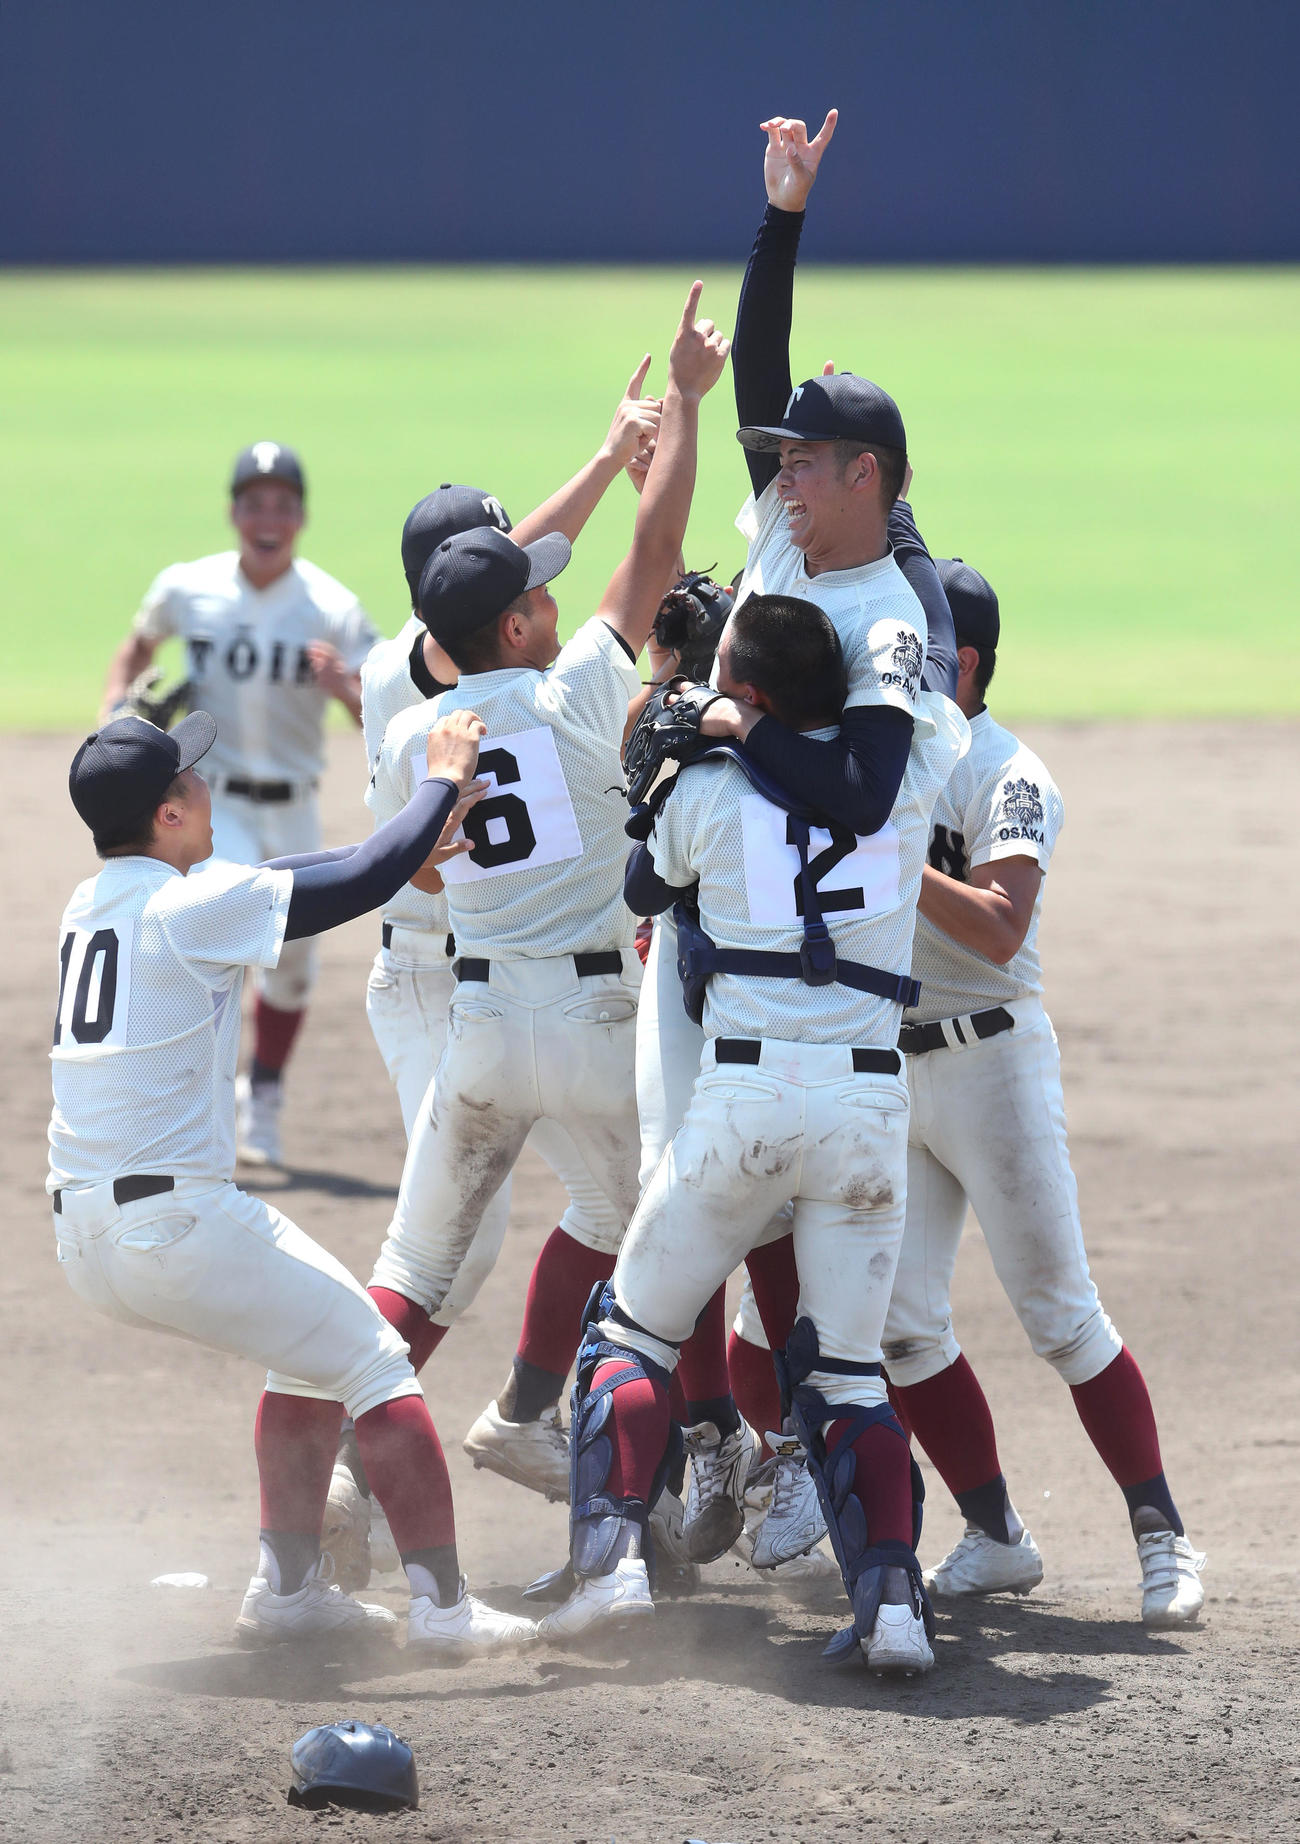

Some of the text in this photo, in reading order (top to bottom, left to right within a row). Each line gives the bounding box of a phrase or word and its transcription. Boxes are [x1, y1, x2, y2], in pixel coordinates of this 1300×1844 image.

[461, 747, 537, 870] 6
[999, 826, 1045, 846] OSAKA
[786, 814, 866, 917] 2
[53, 928, 119, 1045] 10
